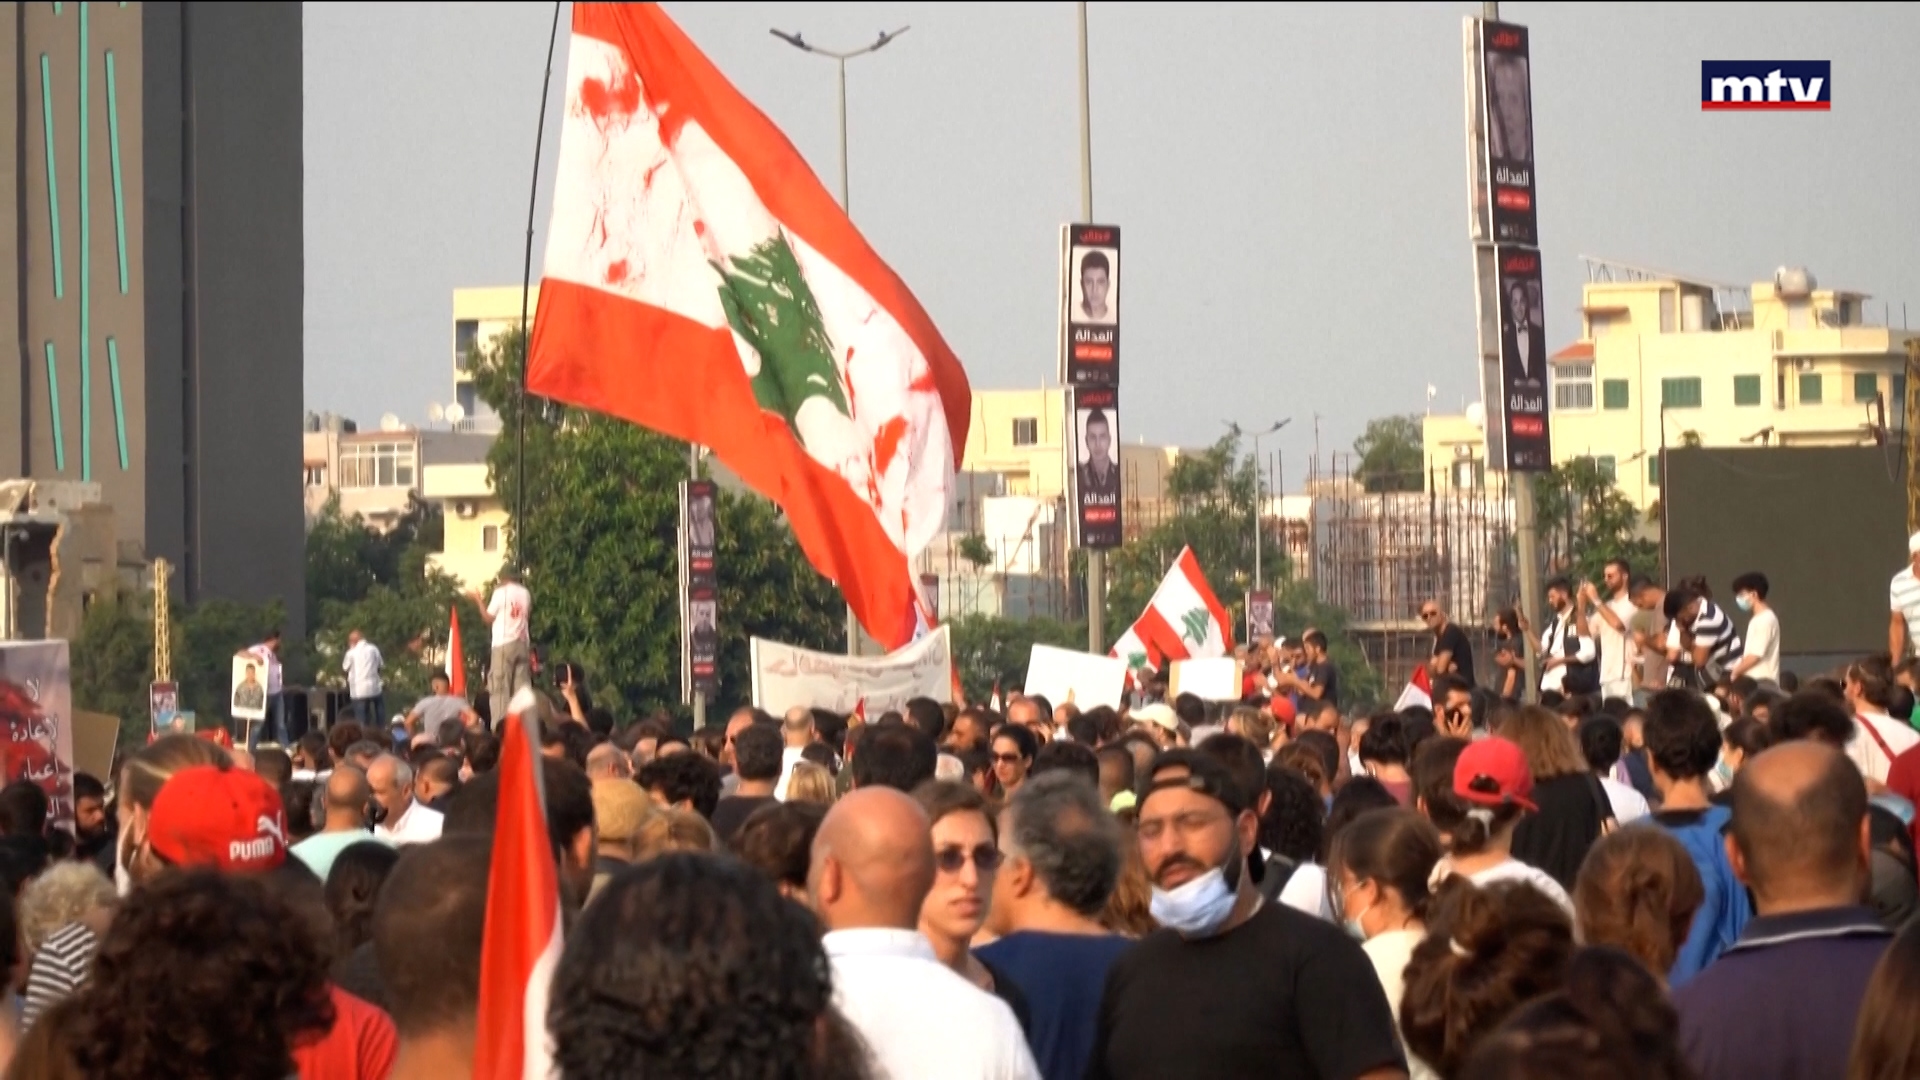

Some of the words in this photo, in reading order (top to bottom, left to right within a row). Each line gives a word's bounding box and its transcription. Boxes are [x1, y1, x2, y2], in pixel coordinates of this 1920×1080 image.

[1075, 329, 1113, 342] العدالة
[1510, 393, 1543, 413] العدالة
[26, 676, 40, 702] لا
[229, 835, 275, 862] PUMA
